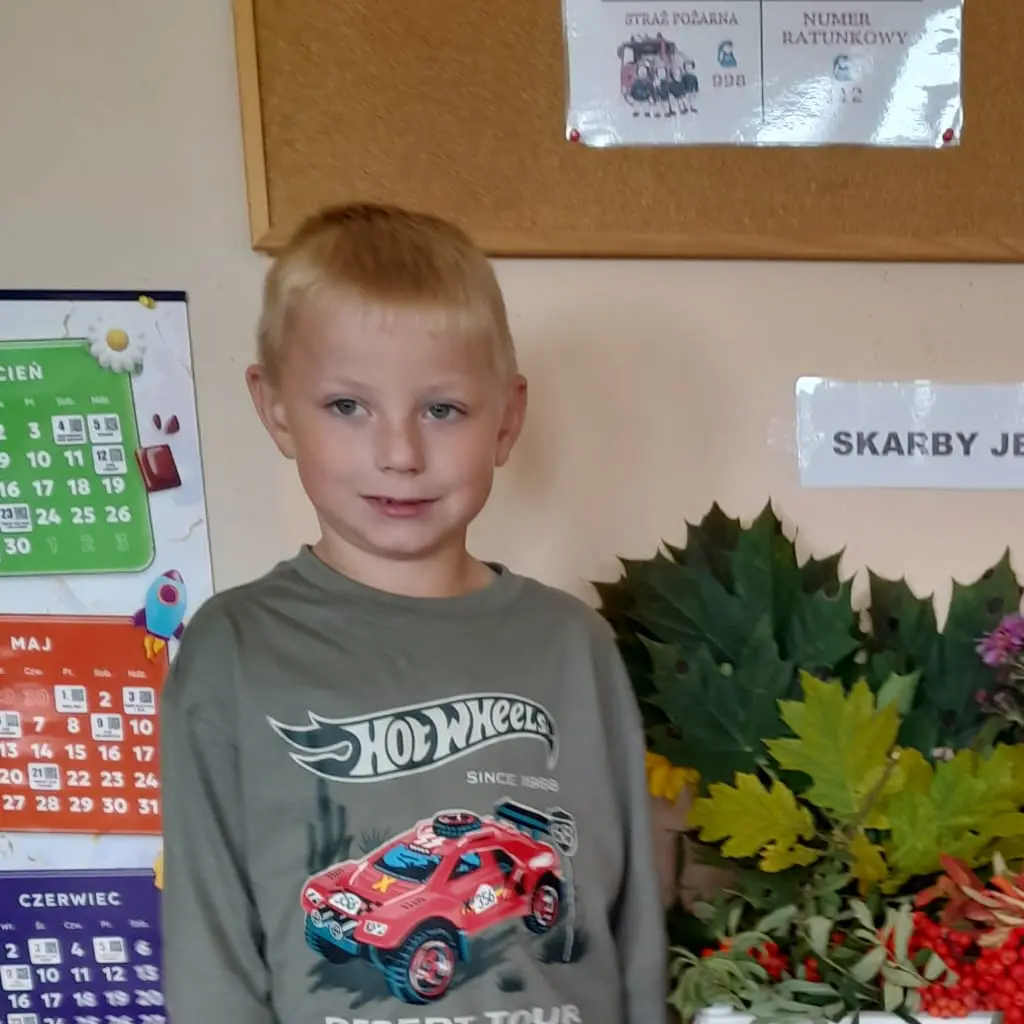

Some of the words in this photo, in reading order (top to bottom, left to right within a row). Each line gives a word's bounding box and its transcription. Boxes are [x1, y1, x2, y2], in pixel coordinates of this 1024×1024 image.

[624, 9, 669, 26] STRAŻ
[672, 9, 740, 26] POŻARNA
[803, 12, 871, 26] NUMER
[782, 30, 908, 45] RATUNKOWY
[28, 421, 41, 439] 3
[832, 430, 979, 457] SKARBY
[26, 450, 52, 468] 10
[63, 449, 84, 467] 11
[96, 449, 108, 462] 12
[0, 480, 21, 498] 16
[32, 478, 54, 497] 17
[66, 477, 92, 496] 18
[101, 476, 126, 495] 19
[35, 507, 62, 526] 24
[70, 506, 96, 525] 25
[104, 505, 132, 523] 26
[4, 536, 32, 555] 30
[10, 635, 52, 651] MAJ
[98, 690, 113, 708] 2
[32, 715, 45, 733] 7
[66, 716, 81, 734] 8
[128, 718, 153, 736] 10
[0, 741, 19, 759] 13
[30, 743, 54, 760] 14
[64, 743, 88, 760] 15
[97, 744, 121, 761] 16
[132, 745, 155, 762] 17
[0, 768, 24, 785] 20
[66, 769, 92, 787] 22
[100, 770, 125, 787] 23
[133, 771, 160, 789] 24
[465, 770, 519, 787] SINCE
[1, 794, 26, 811] 27
[35, 795, 61, 812] 28
[68, 796, 94, 813] 29
[101, 797, 128, 815] 30
[137, 797, 159, 815] 31
[18, 891, 123, 908] CZERWIEC
[4, 942, 20, 959] 2
[70, 941, 86, 957] 4
[36, 967, 61, 983] 10
[70, 966, 90, 982] 11
[102, 965, 129, 982] 12
[7, 993, 31, 1009] 16
[40, 992, 63, 1009] 17
